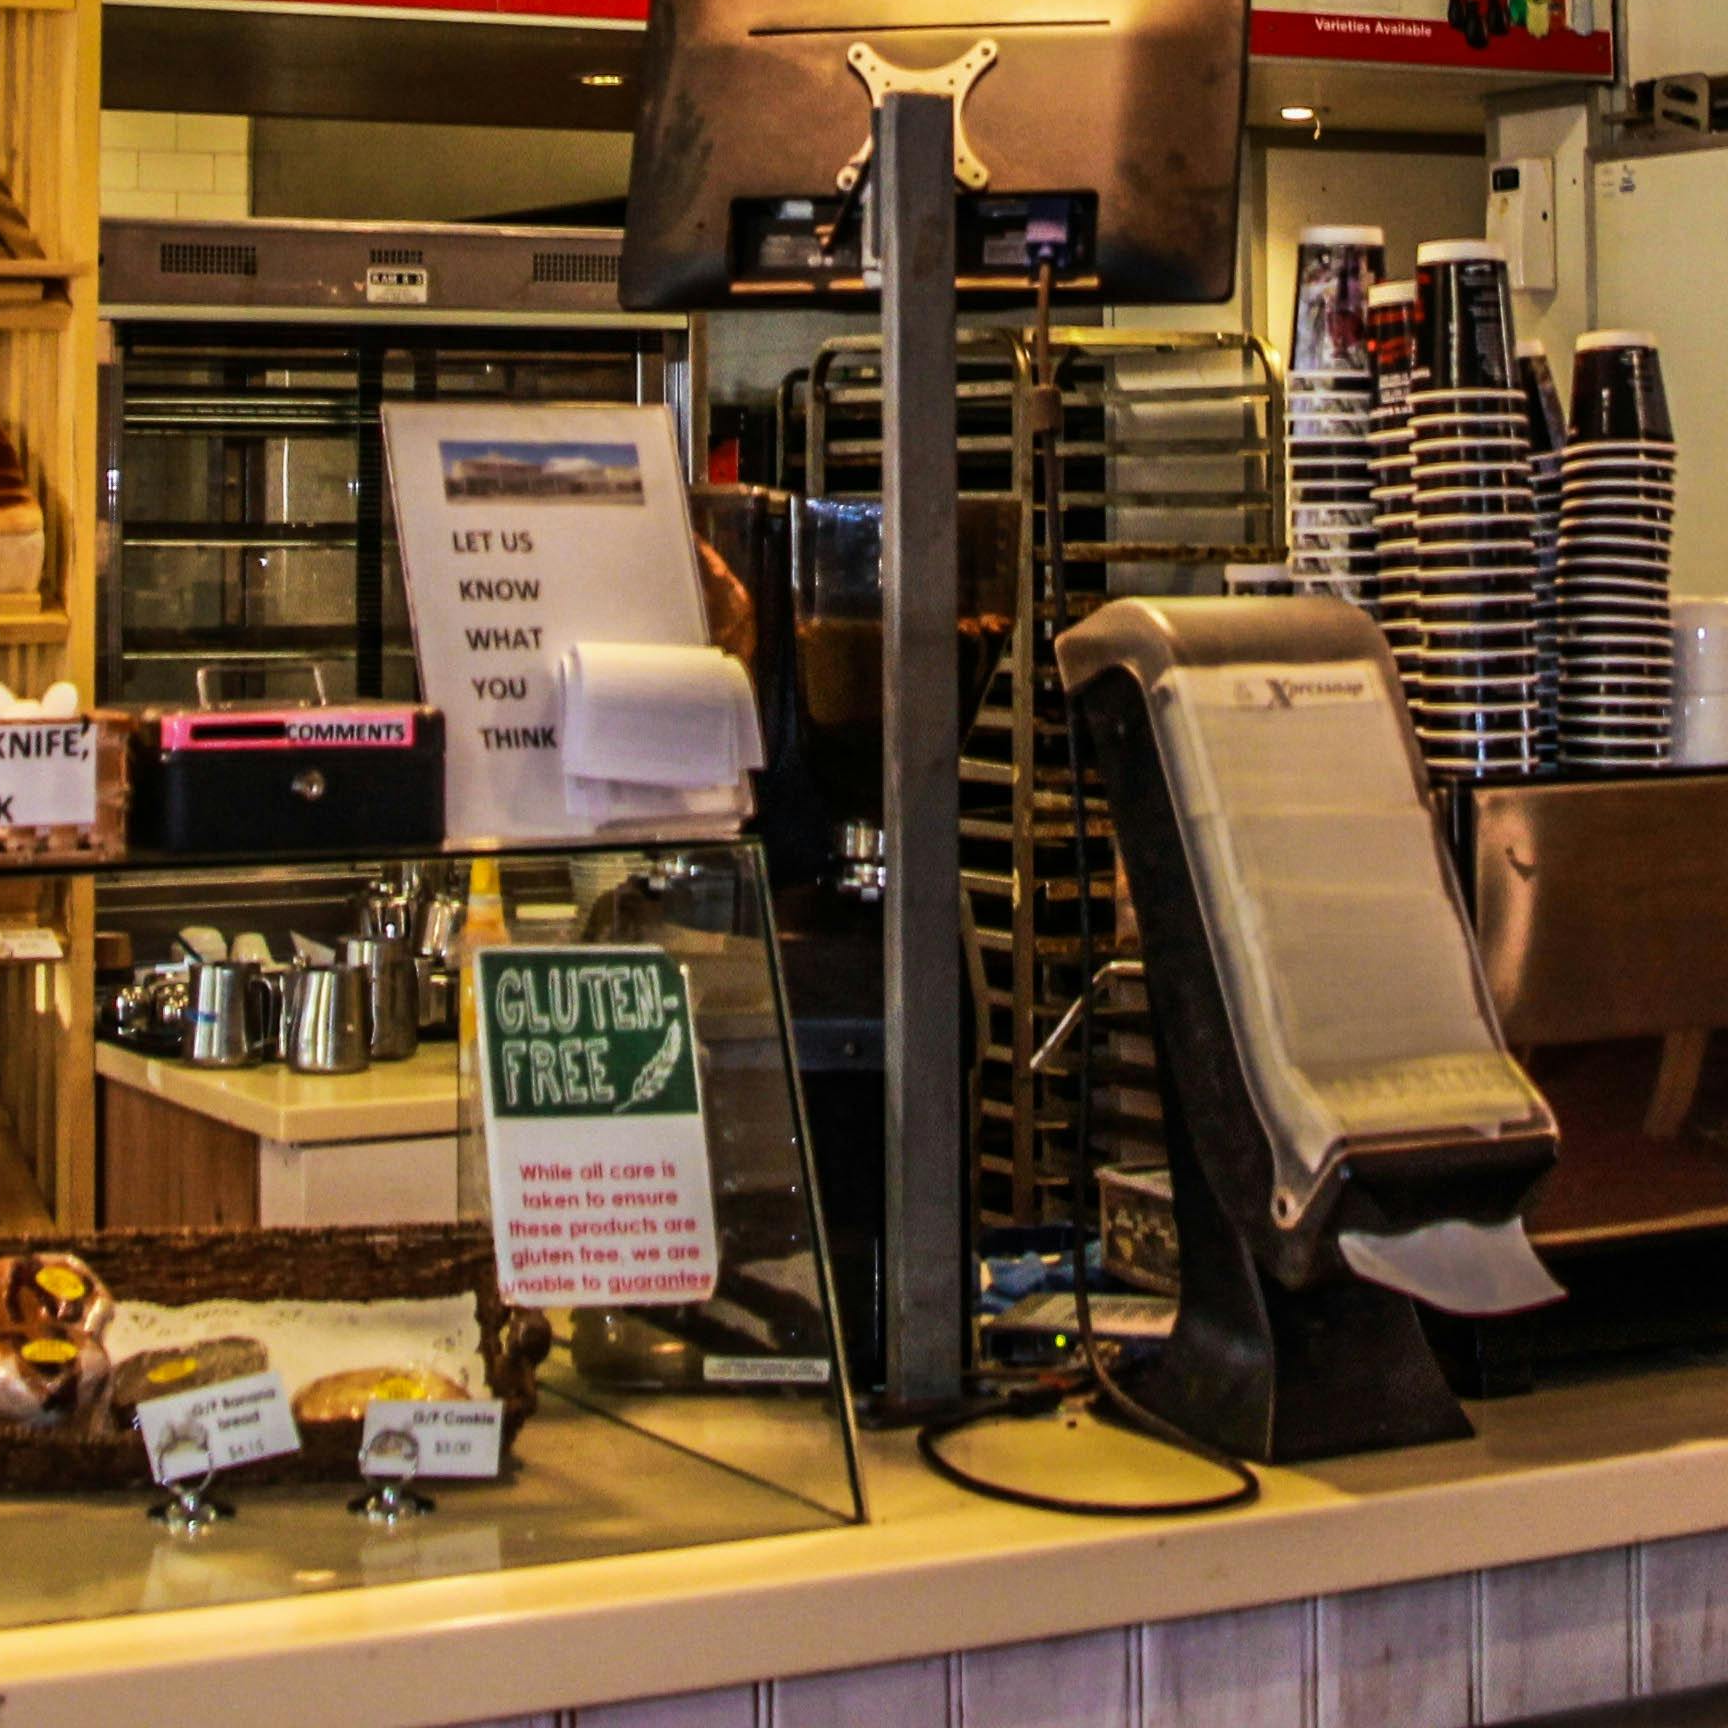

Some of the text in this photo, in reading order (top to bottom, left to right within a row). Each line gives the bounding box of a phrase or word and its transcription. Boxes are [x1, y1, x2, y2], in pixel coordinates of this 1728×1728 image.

[1314, 17, 1433, 40] Varieties Available
[452, 530, 534, 555] LET US
[459, 579, 541, 602] KNOW
[465, 627, 543, 651] WHAT
[472, 677, 527, 700] YOU
[286, 722, 405, 742] COMMENTS
[480, 726, 558, 751] THINK
[501, 1036, 616, 1108] FREE
[519, 1161, 676, 1182] While all care is
[522, 1190, 679, 1209] taken to ensure
[508, 1217, 698, 1242] these products are
[511, 1246, 575, 1270] gluten
[632, 1245, 661, 1263] we
[667, 1244, 701, 1261] are
[503, 1269, 714, 1297] unable to guarantee
